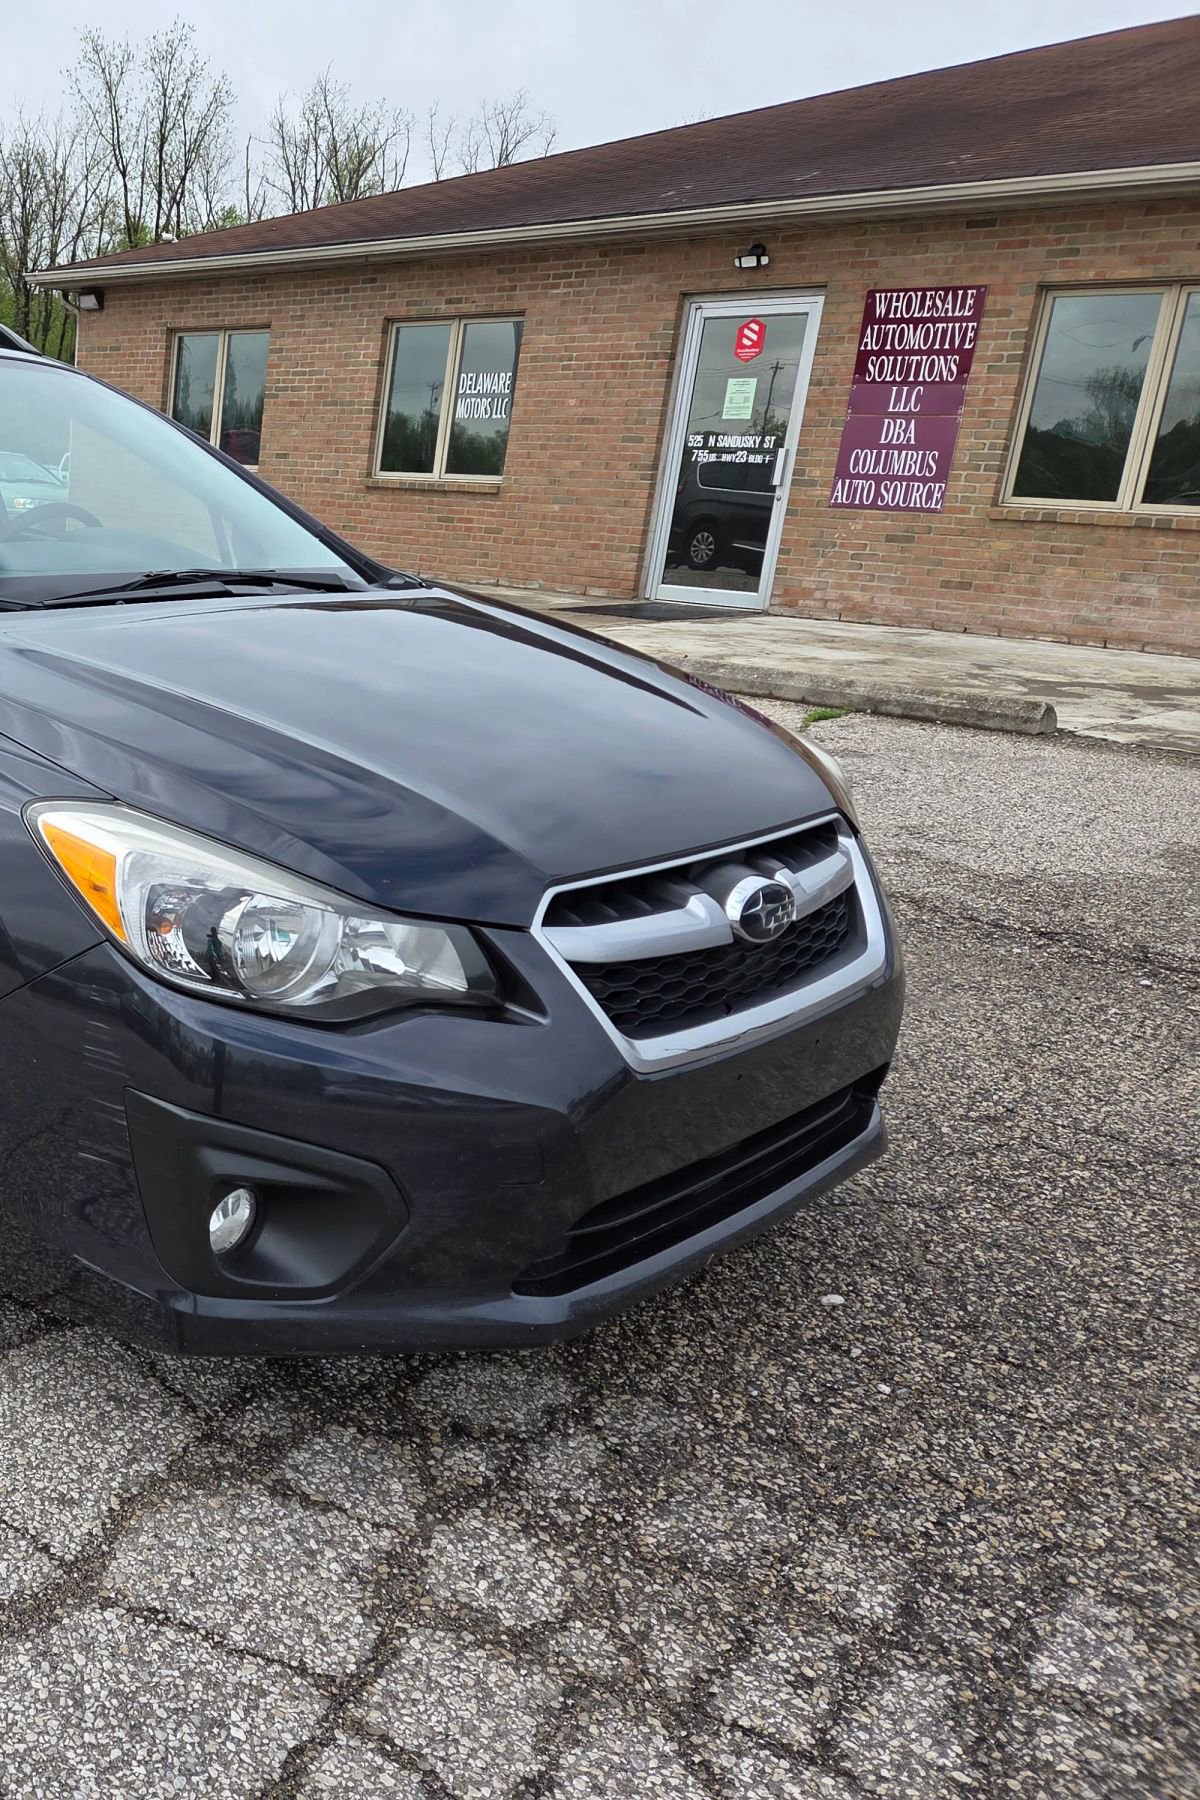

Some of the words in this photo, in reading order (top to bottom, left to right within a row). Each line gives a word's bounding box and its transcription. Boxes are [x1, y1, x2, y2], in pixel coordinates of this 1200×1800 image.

[875, 289, 976, 318] WHOLESALE
[860, 322, 977, 350] AUTOMOTIVE
[865, 355, 959, 382] SOLUTIONS
[458, 372, 512, 394] DELAWARE
[456, 398, 492, 419] MOTORS
[492, 398, 509, 419] LLC
[888, 386, 923, 412] LLC
[688, 435, 704, 447] 525
[708, 435, 716, 447] N
[717, 435, 761, 448] SANDUSKY
[763, 436, 776, 448] ST
[880, 418, 915, 444] DBA
[849, 449, 938, 477] COLUMBUS
[831, 479, 875, 505] AUTO
[877, 481, 945, 509] SOURCE
